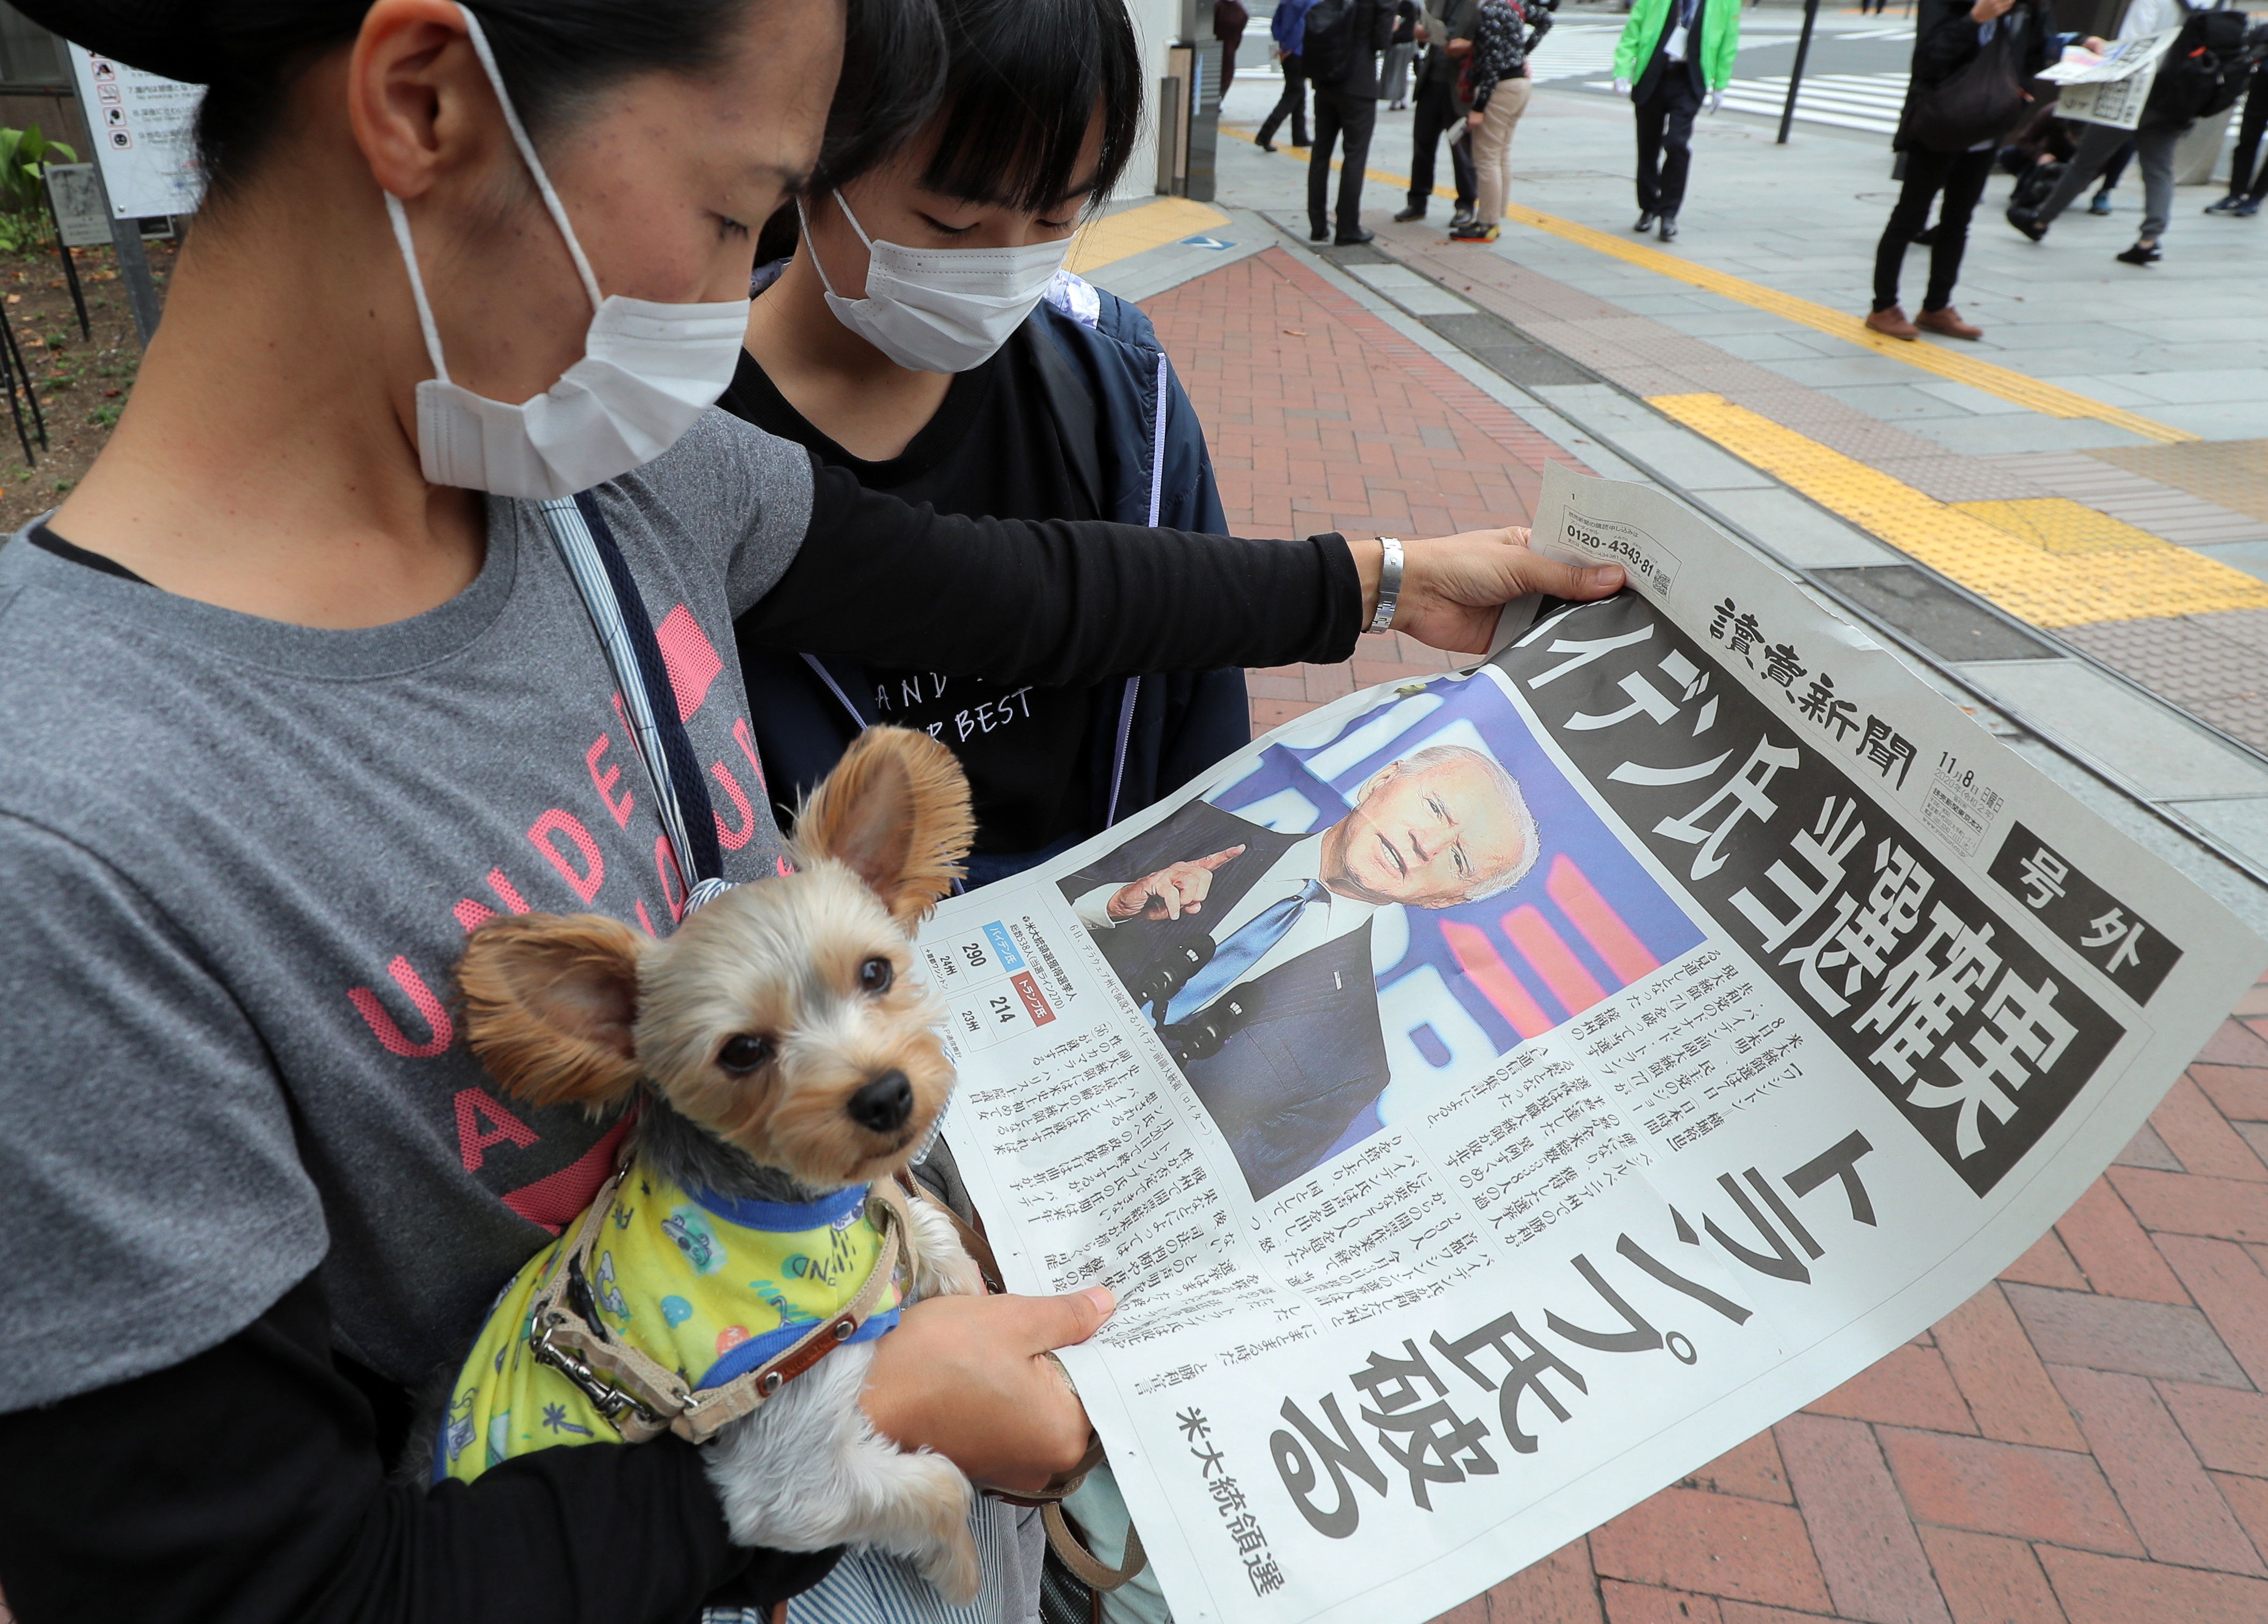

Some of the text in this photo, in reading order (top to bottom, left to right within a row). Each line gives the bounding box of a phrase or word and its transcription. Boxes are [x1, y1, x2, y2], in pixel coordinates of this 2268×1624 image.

[1567, 524, 1654, 577] 0120-4343-81
[876, 672, 947, 711] AND
[954, 685, 1034, 743] BEST
[1980, 786, 2004, 813] 日曜日
[2019, 847, 2146, 974] 号外
[961, 942, 986, 967] 290
[989, 927, 1017, 964] バイデン氏
[939, 955, 958, 976] 24州
[989, 996, 1016, 1023] 214
[1018, 979, 1047, 1018] トランプ氏
[961, 1010, 981, 1032] 23州
[1269, 1128, 1878, 1540] トランプ氏破る
[1175, 1405, 1287, 1598] 米大統領選
